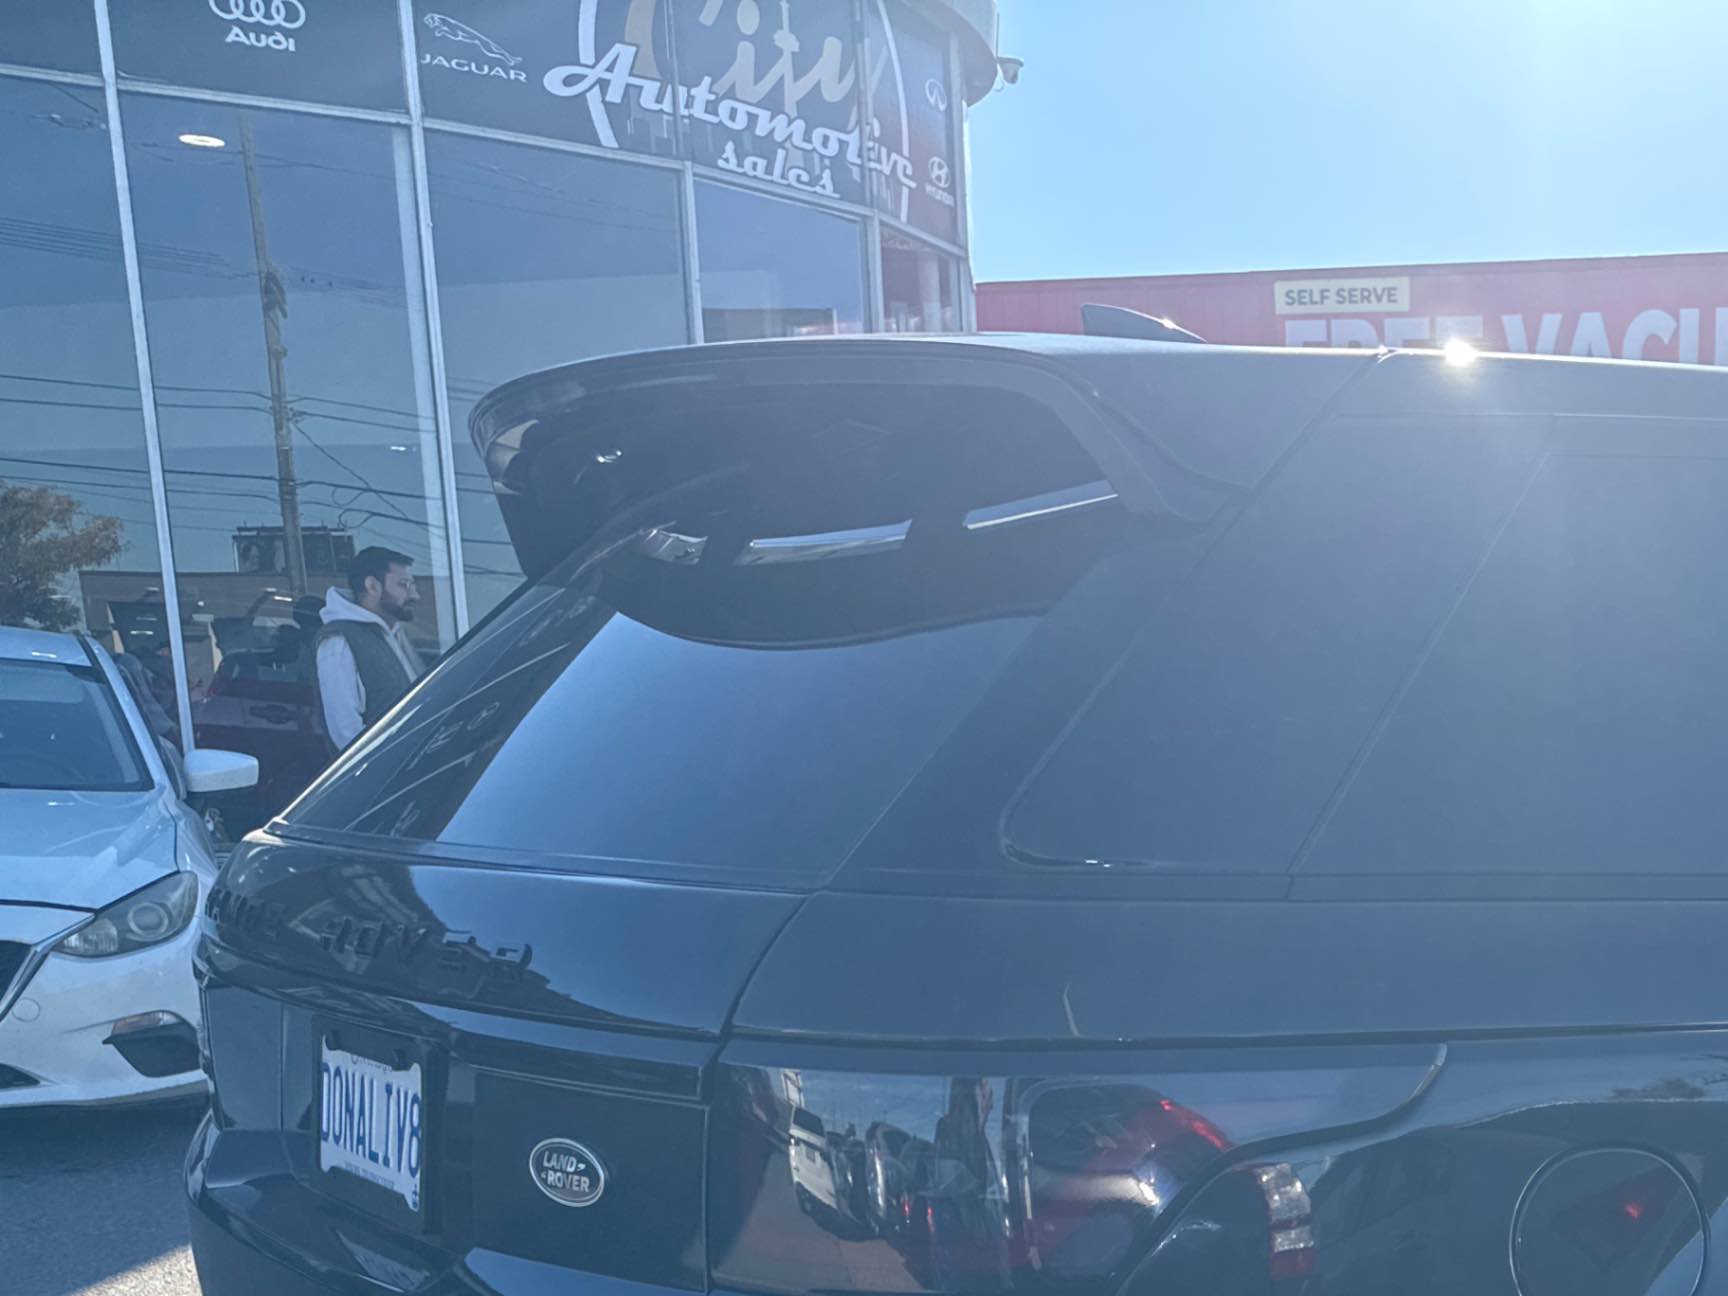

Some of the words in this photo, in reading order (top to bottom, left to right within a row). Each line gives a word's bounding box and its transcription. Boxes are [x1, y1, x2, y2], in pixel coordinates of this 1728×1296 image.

[225, 25, 297, 51] Audi
[420, 53, 528, 82] JAGUAR
[717, 140, 841, 199] sales
[1284, 288, 1331, 306] SELF
[1335, 286, 1398, 305] SERVE
[543, 1150, 578, 1173] LAND
[547, 1169, 591, 1192] ROVER
